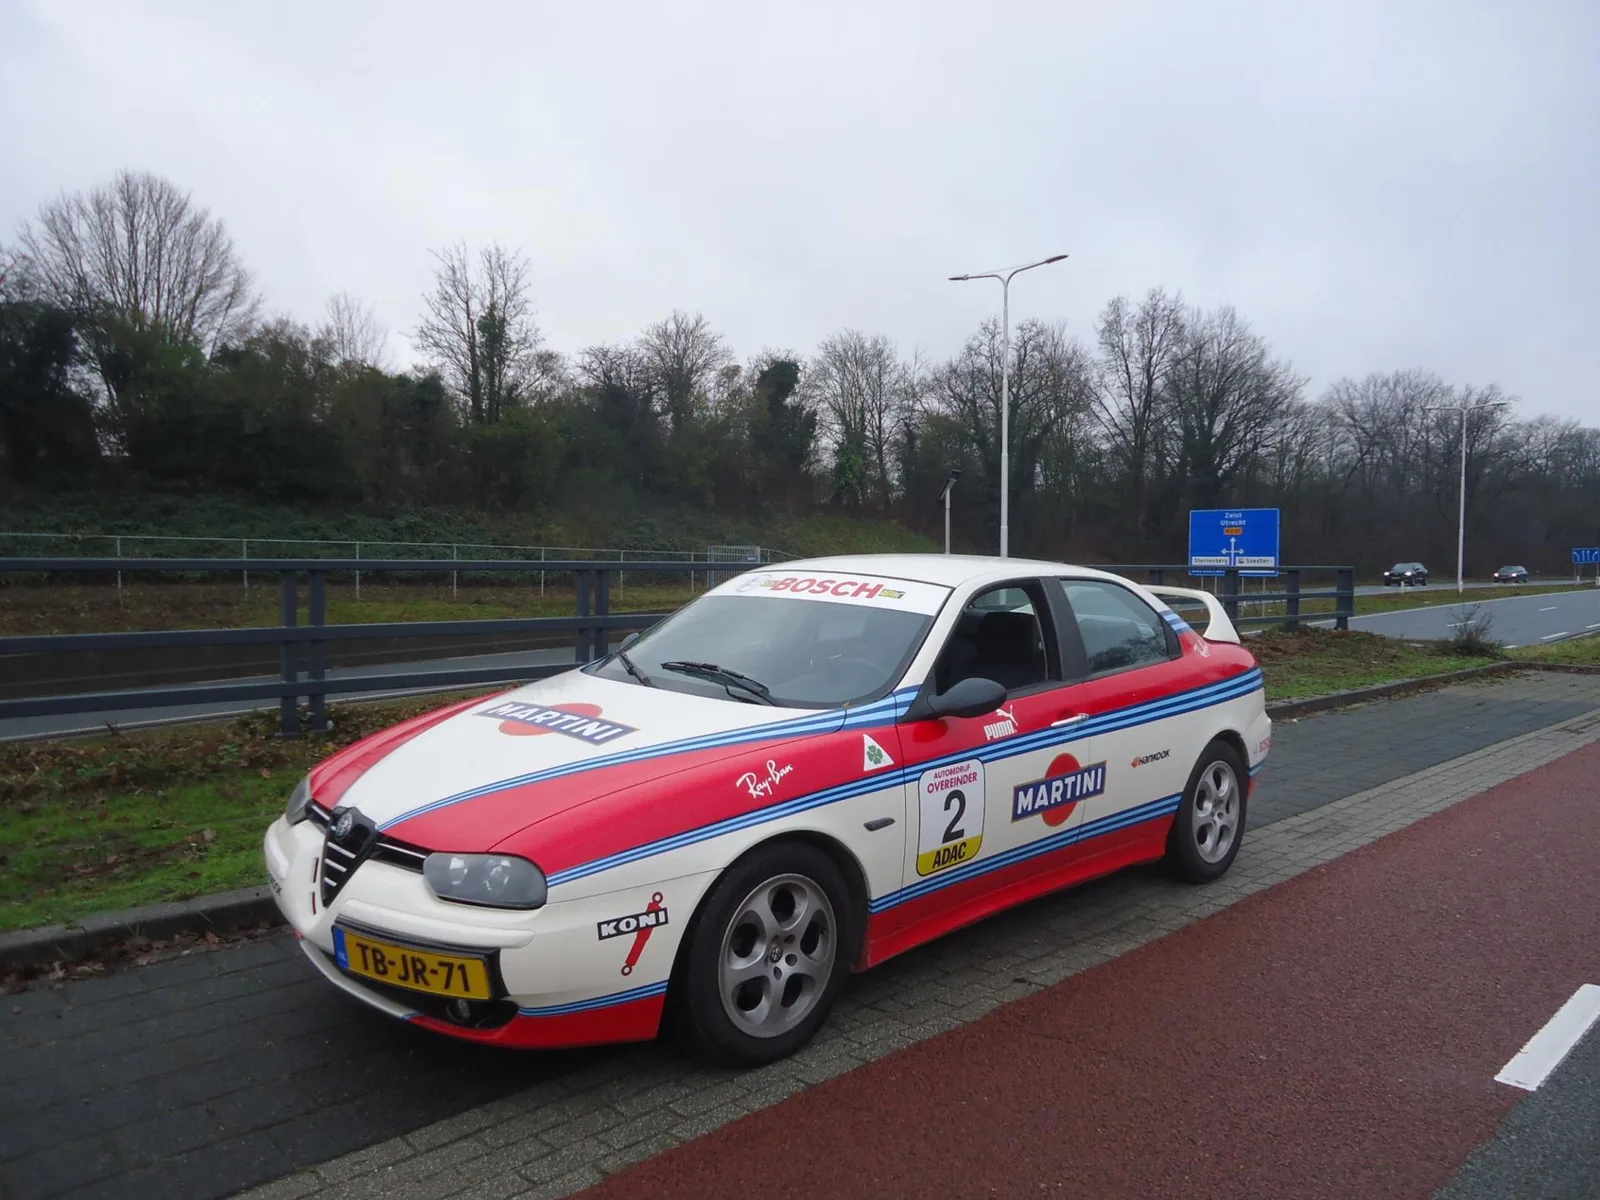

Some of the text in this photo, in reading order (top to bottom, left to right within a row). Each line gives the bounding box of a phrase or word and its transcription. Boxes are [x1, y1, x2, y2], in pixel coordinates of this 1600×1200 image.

[769, 577, 884, 599] BOSCH
[487, 703, 624, 741] MARTINI
[983, 719, 1015, 741] PUMA
[927, 772, 978, 794] OVEREINDER
[933, 763, 971, 780] AUTOBEDRIJF
[1016, 767, 1103, 815] MARTINI
[941, 788, 967, 844] 2
[931, 841, 967, 870] ADAC
[600, 909, 667, 938] KONI
[356, 941, 471, 992] TB-JR-71
